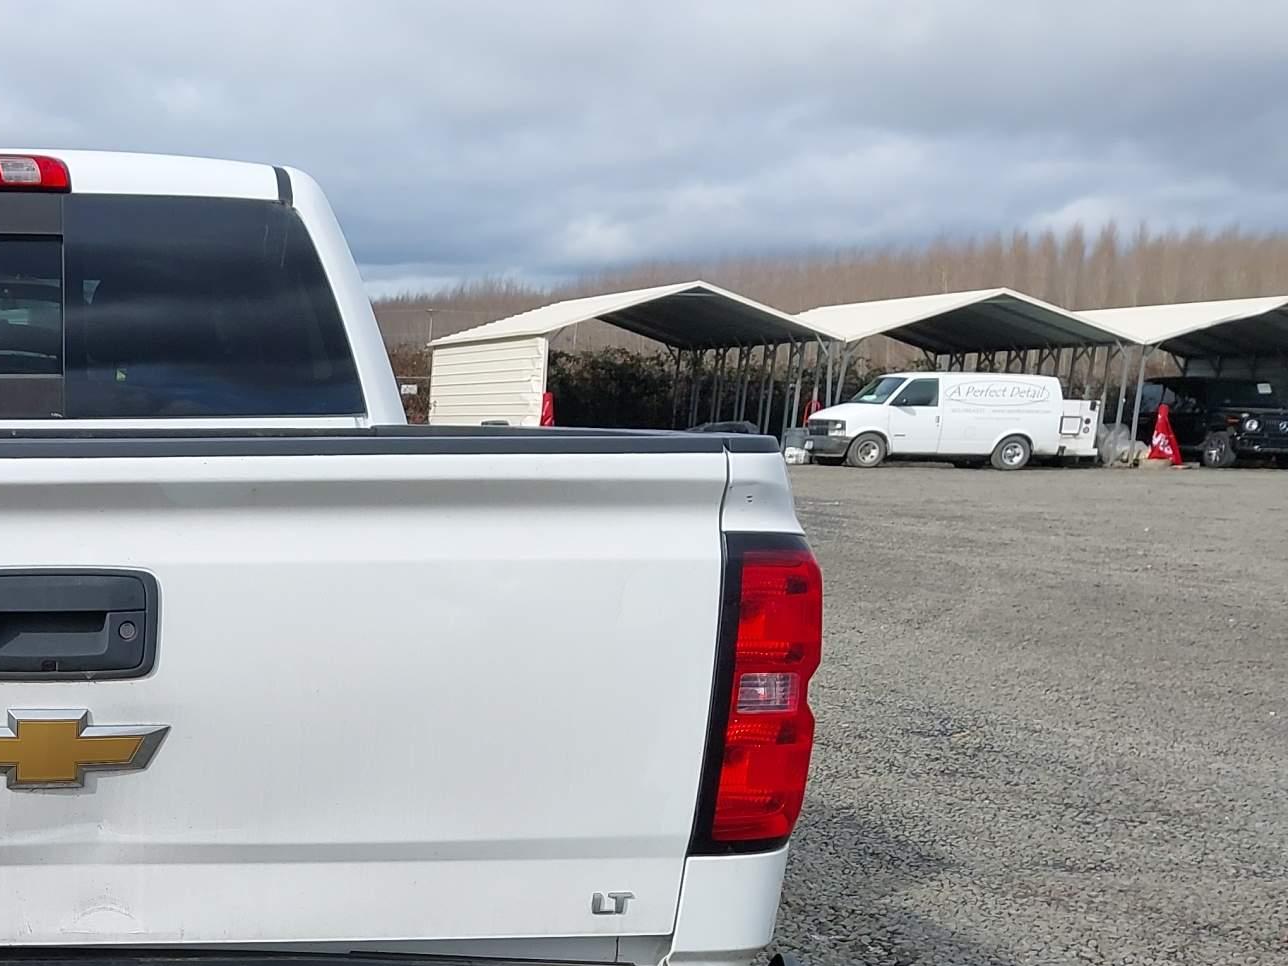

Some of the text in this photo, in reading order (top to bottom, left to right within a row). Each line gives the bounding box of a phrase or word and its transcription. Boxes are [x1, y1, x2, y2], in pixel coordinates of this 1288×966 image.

[950, 382, 1047, 400] A Perfect Detail
[592, 891, 635, 915] LT
